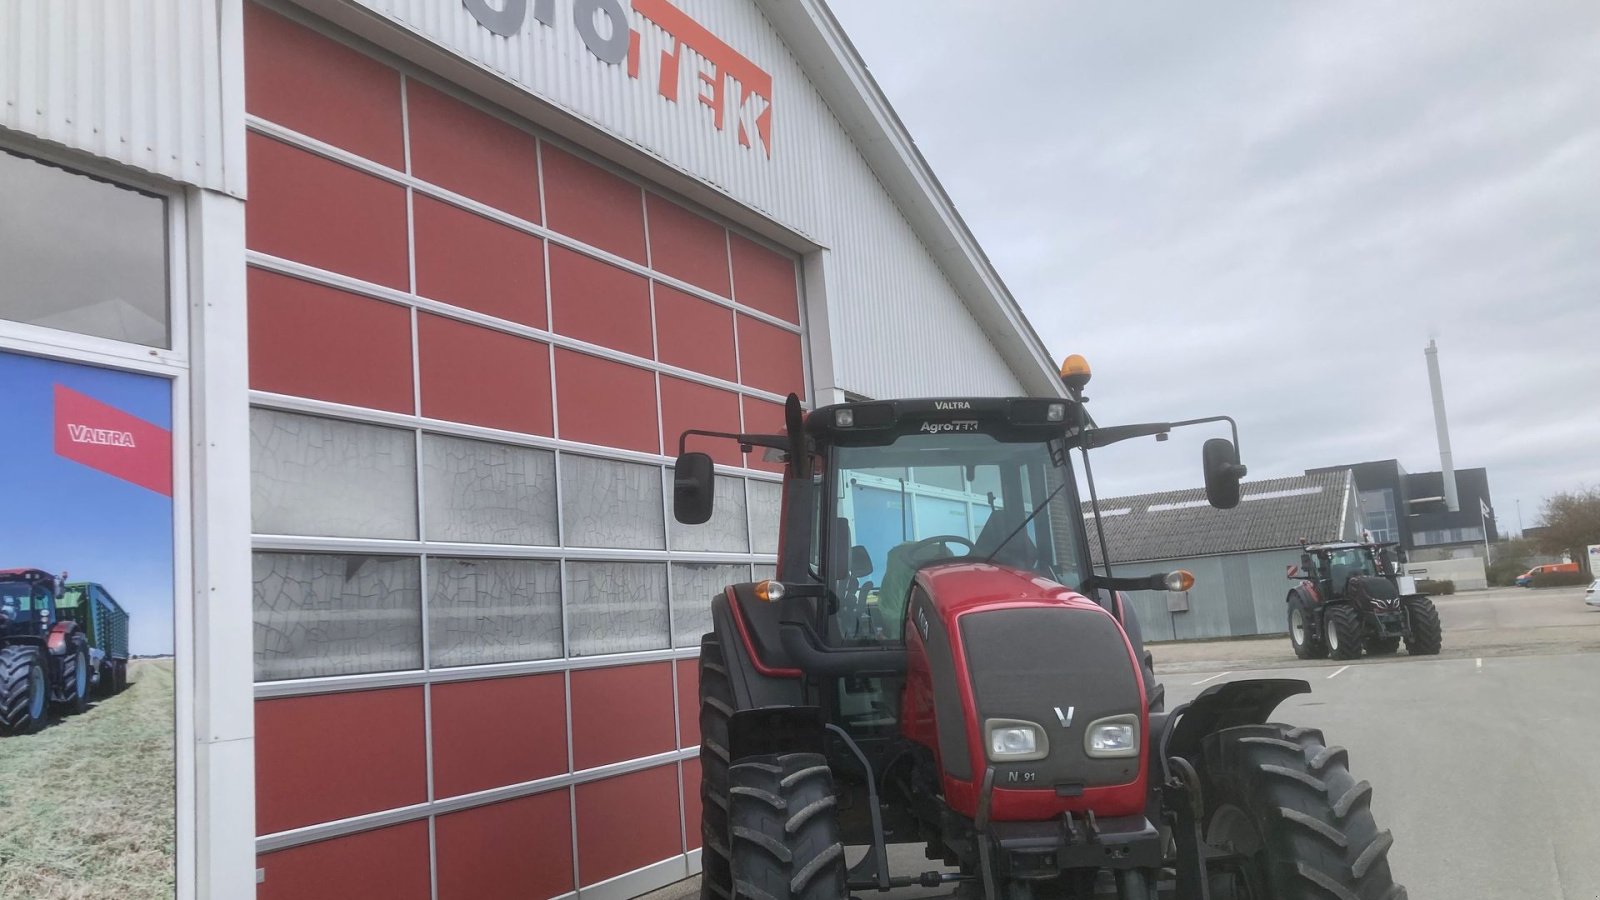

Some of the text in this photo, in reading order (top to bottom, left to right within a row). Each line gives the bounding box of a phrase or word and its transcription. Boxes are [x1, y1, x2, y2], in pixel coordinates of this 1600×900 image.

[934, 401, 971, 410] VALTRA
[920, 420, 979, 434] AgroTEK
[67, 423, 136, 448] VALTRA
[1008, 771, 1036, 782] N 91
